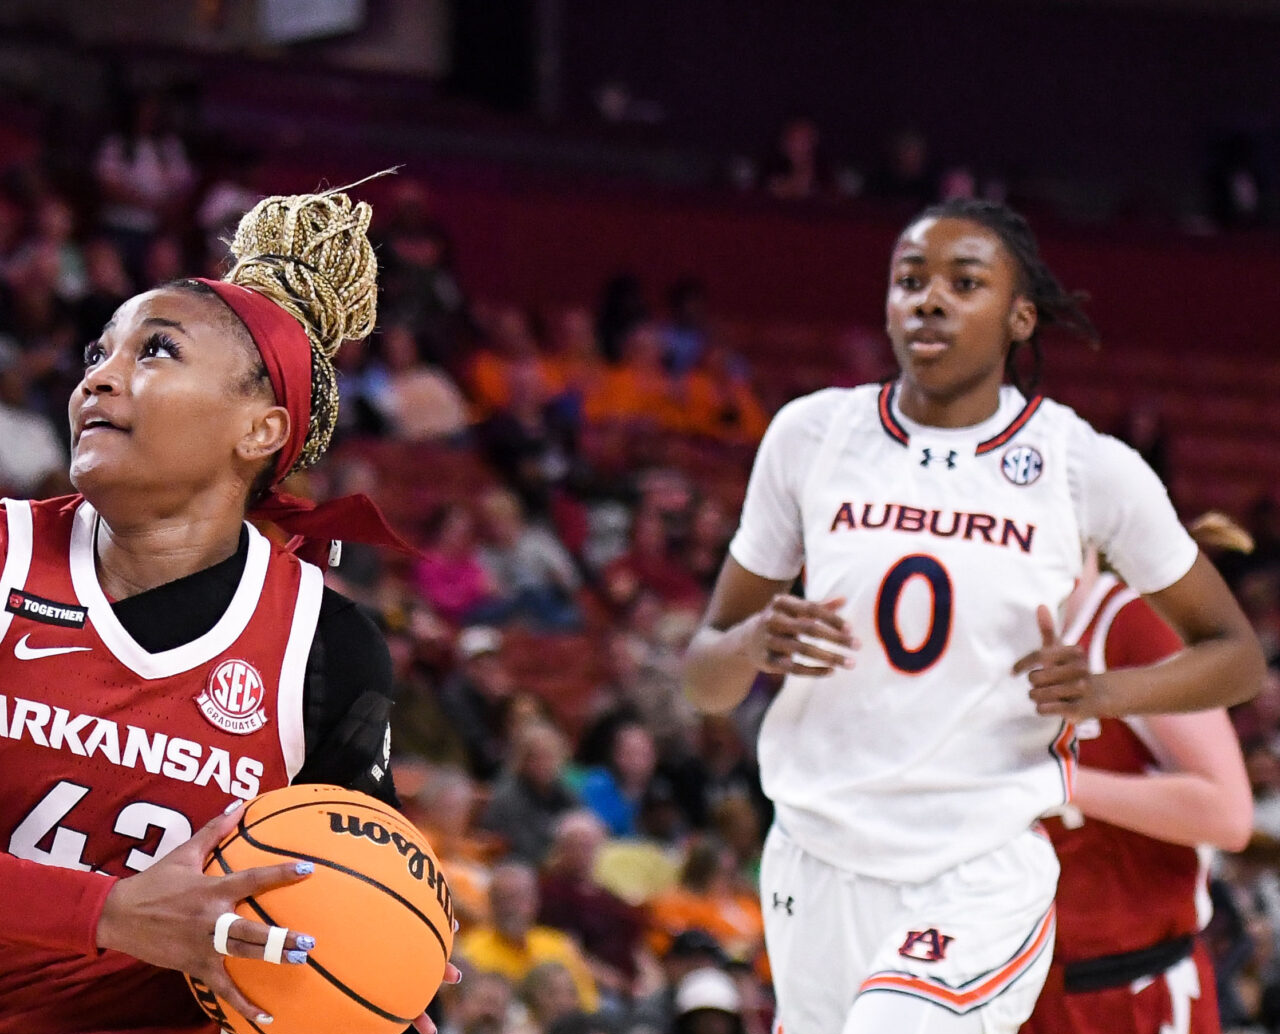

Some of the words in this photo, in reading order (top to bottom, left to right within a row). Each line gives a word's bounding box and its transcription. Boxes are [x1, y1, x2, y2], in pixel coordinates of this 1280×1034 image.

[829, 501, 1037, 554] AUBURN
[23, 598, 85, 623] TOGETHER
[874, 552, 956, 678] 0
[213, 661, 261, 713] SEC
[206, 706, 257, 730] GRADUATE
[8, 779, 193, 877] 43
